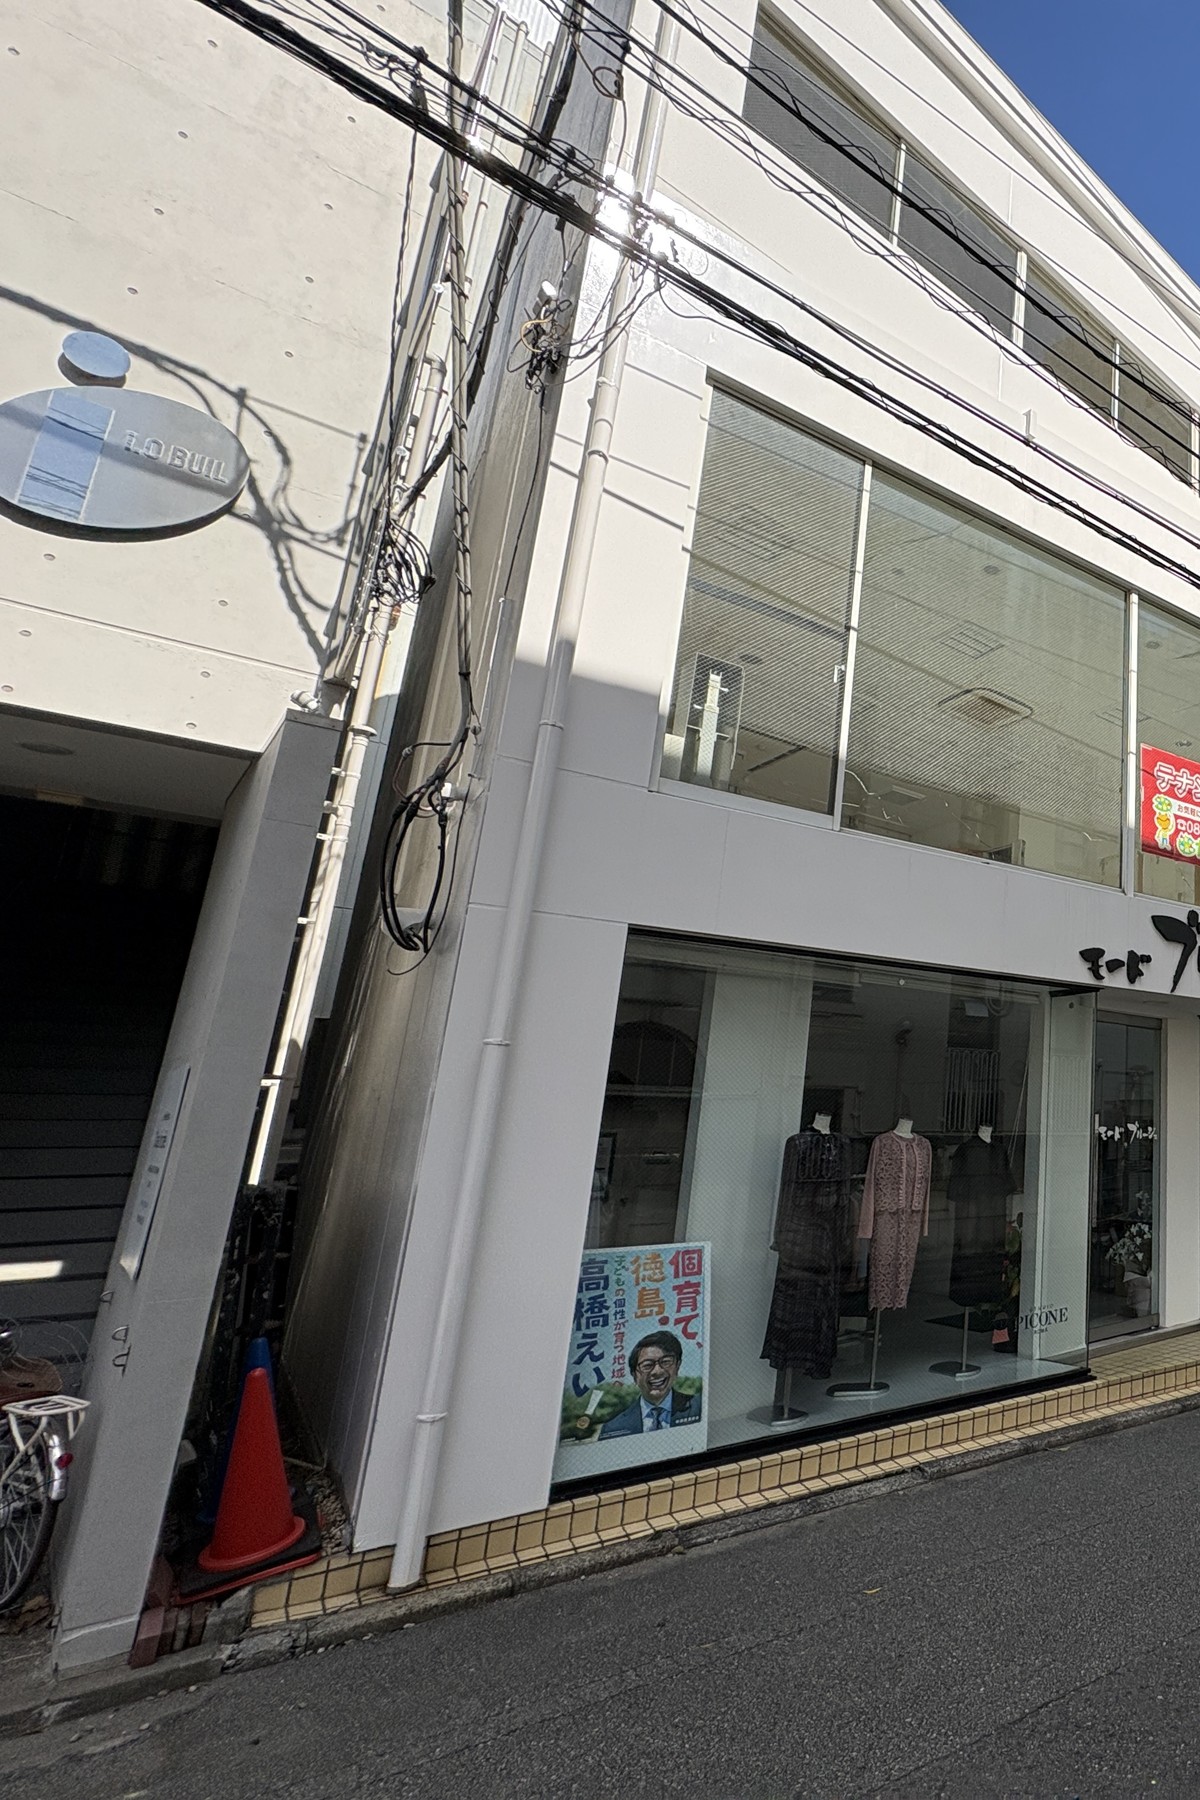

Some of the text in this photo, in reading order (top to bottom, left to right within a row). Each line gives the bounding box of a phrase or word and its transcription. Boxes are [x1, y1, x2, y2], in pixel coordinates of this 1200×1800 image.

[166, 444, 230, 484] BUIL
[1078, 946, 1153, 984] モード
[611, 1254, 629, 1388] 子どもの個性が育つ地域へ
